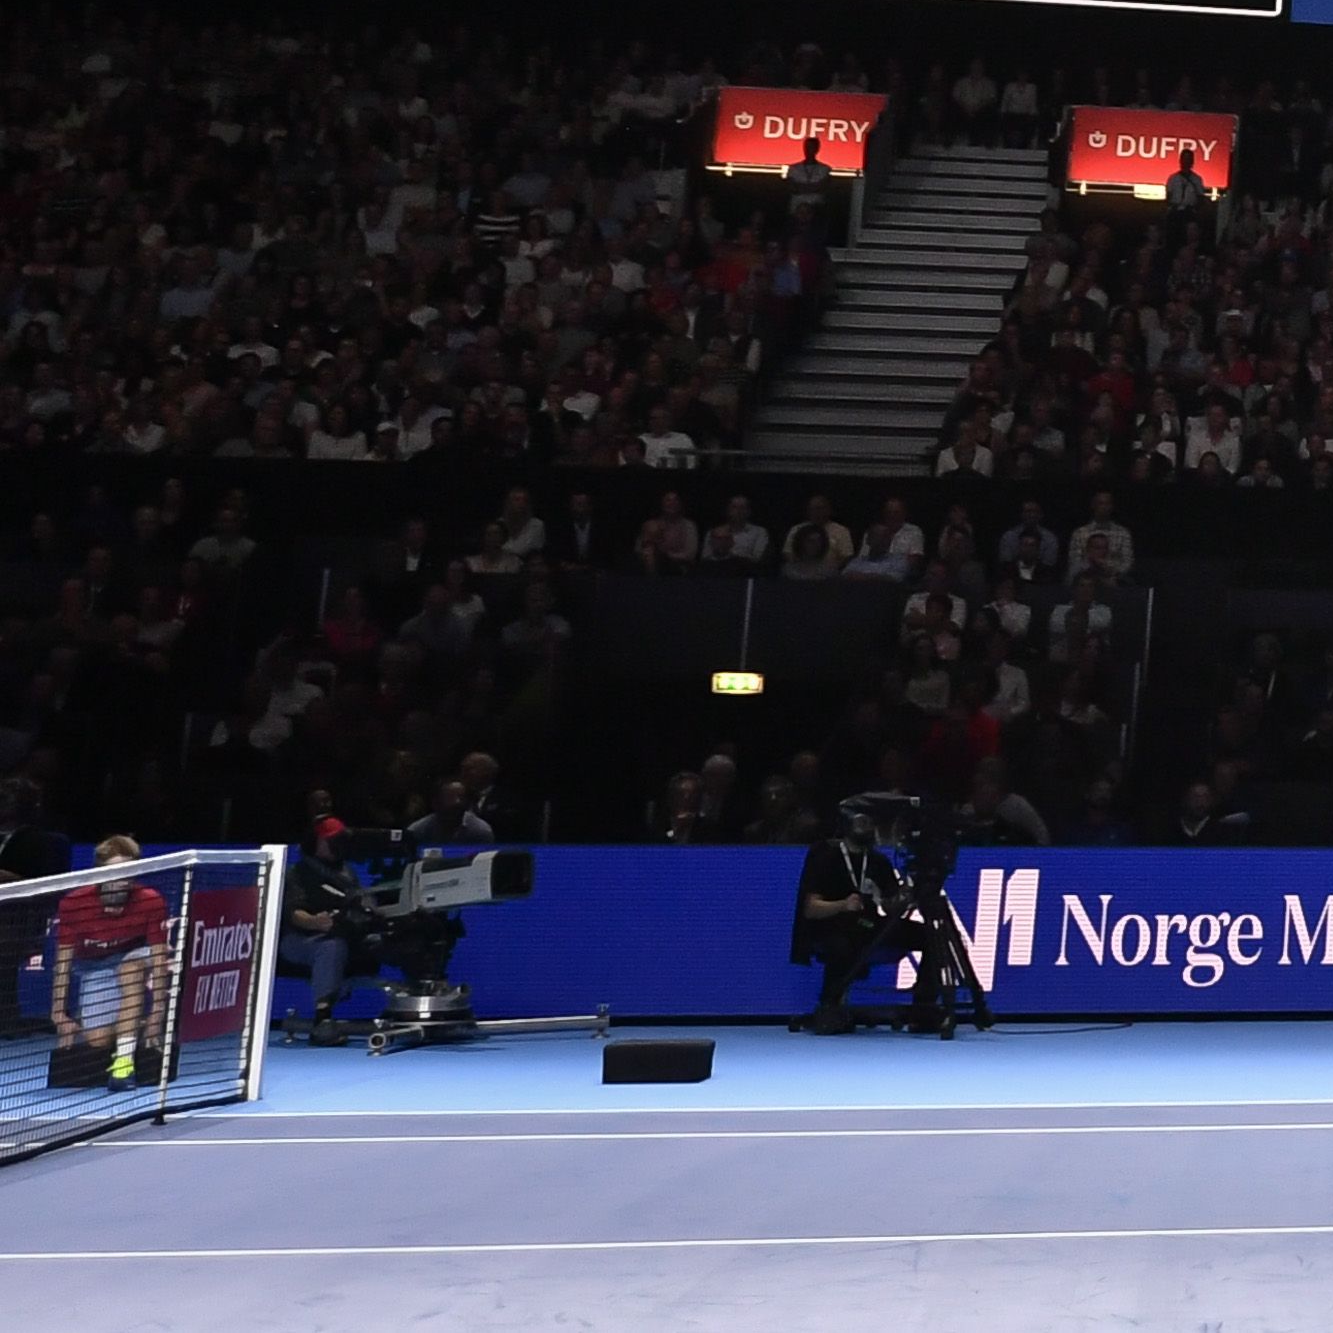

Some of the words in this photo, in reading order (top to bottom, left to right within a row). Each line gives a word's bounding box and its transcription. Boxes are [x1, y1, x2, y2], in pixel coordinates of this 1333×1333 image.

[763, 116, 871, 143] DUFRY
[191, 916, 254, 967] Emirates
[1057, 893, 1263, 988] Norge
[193, 976, 211, 1015] FLY
[209, 969, 241, 1011] BETTER
